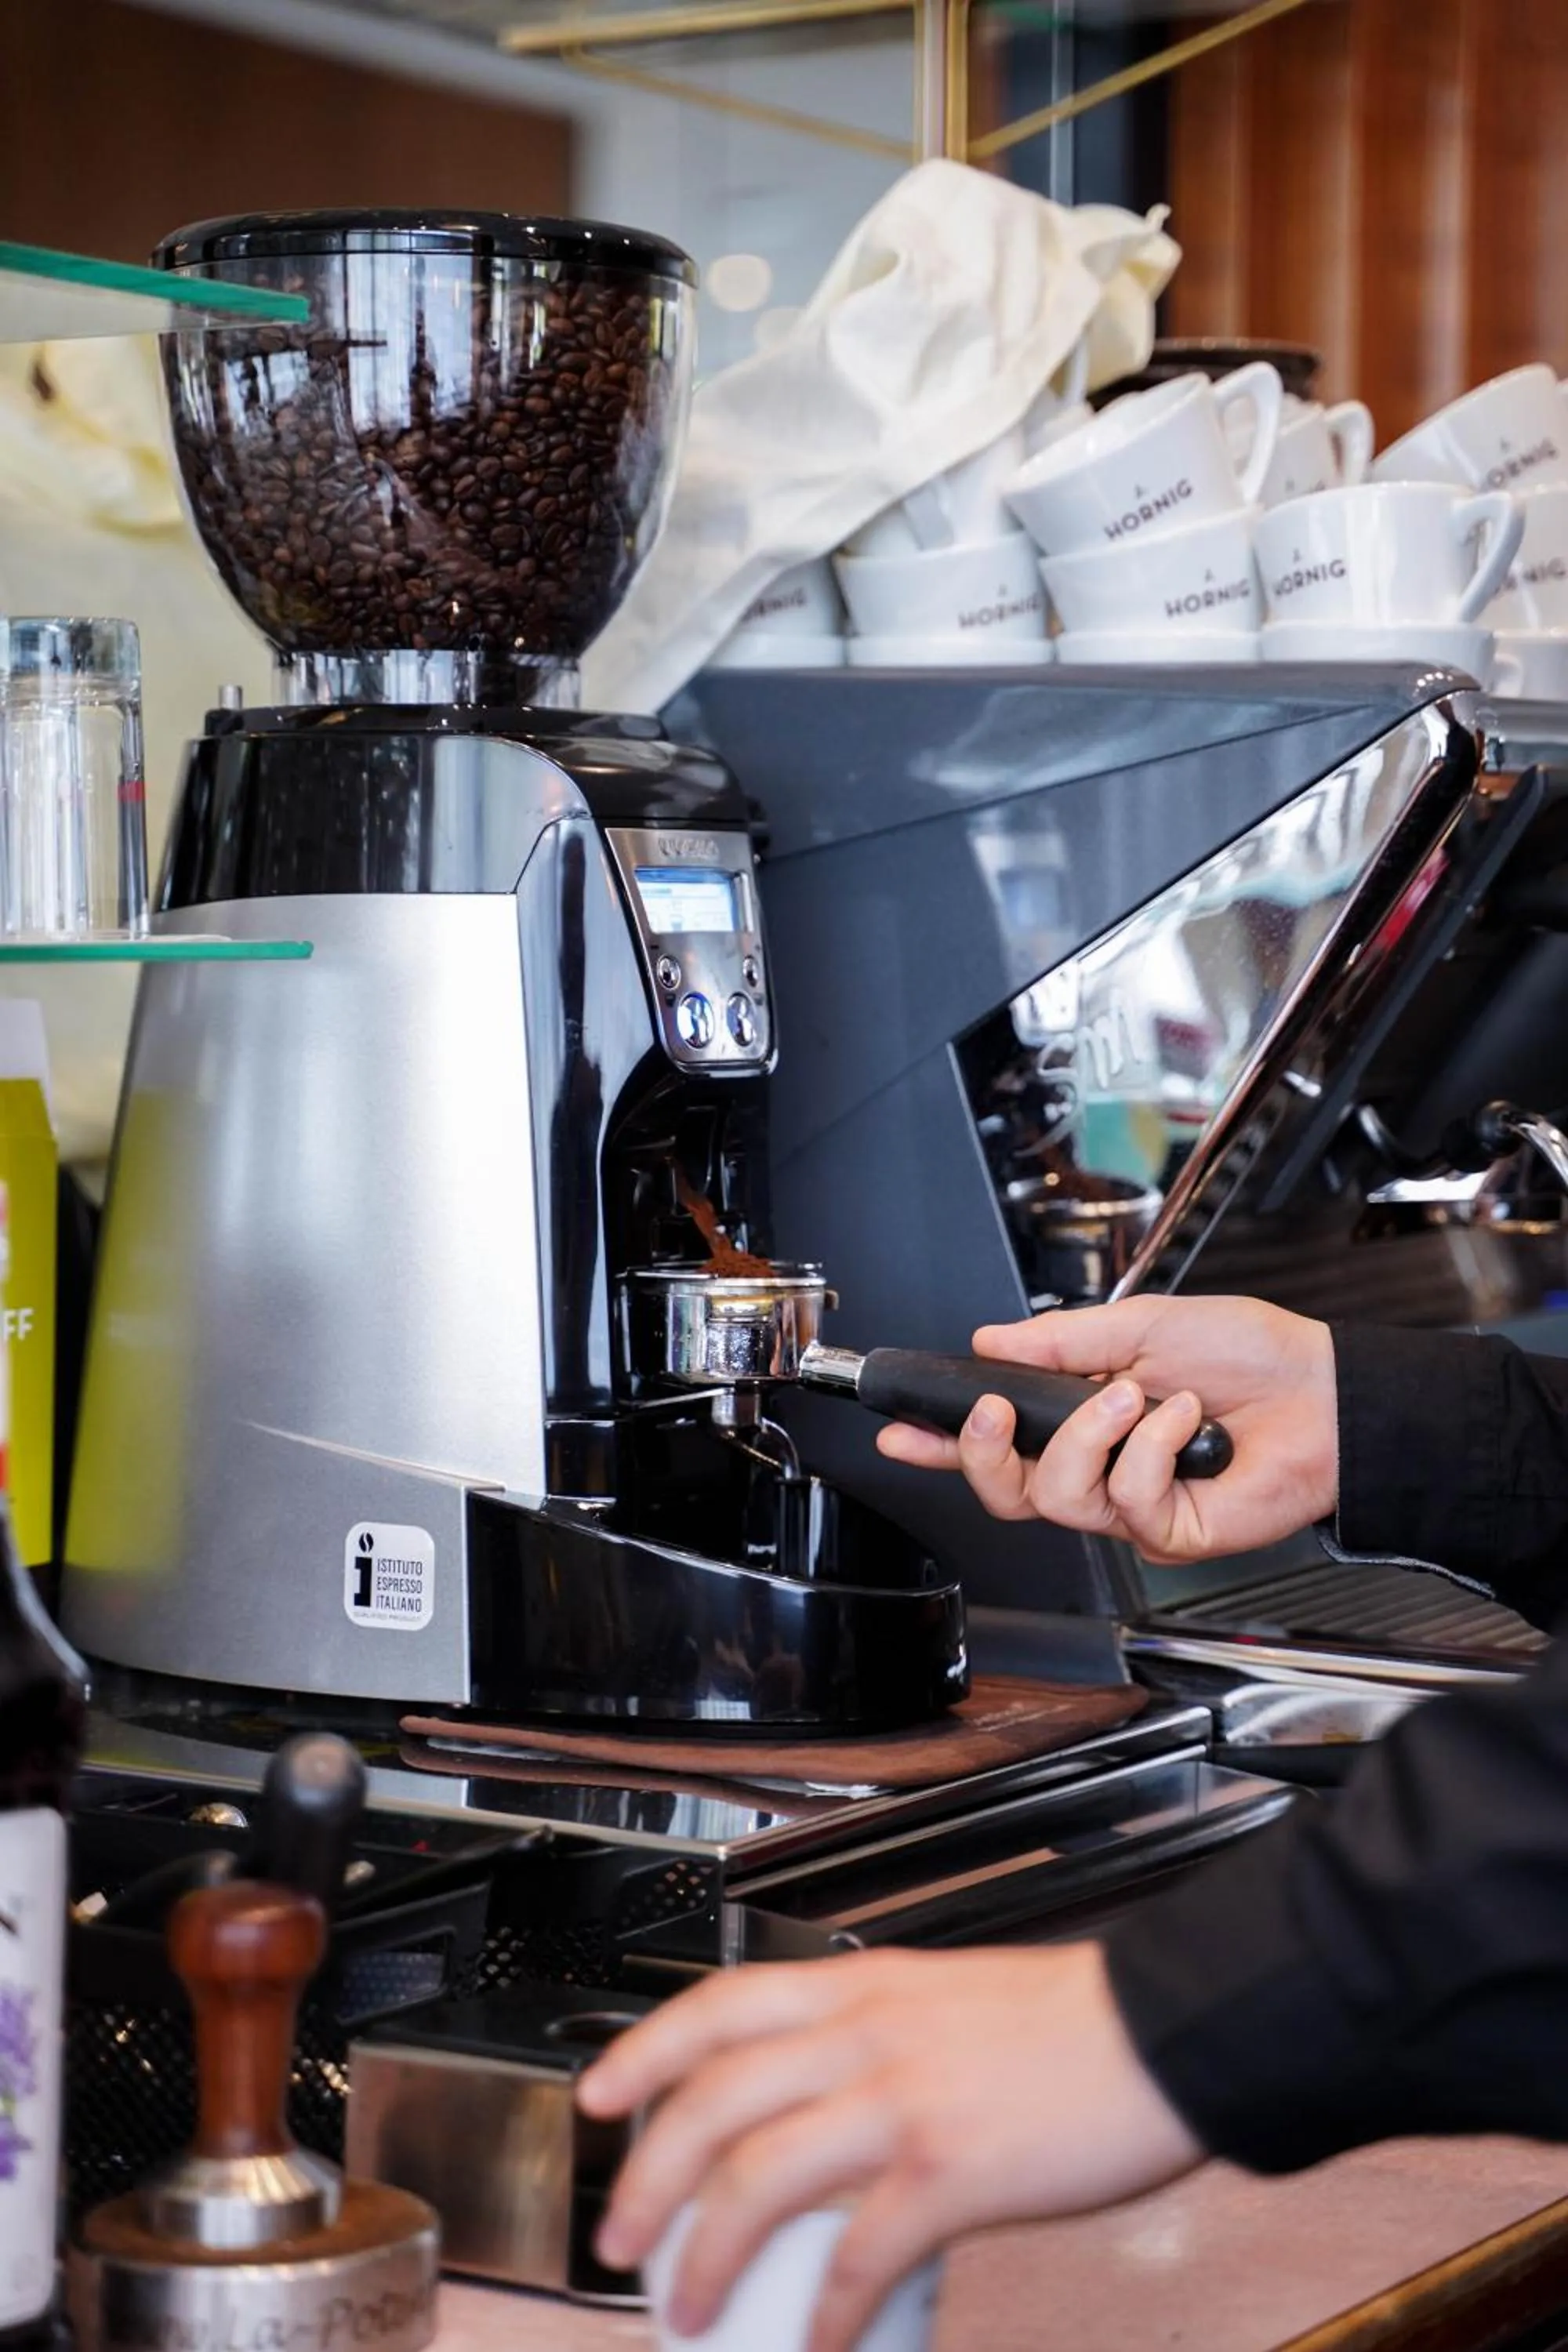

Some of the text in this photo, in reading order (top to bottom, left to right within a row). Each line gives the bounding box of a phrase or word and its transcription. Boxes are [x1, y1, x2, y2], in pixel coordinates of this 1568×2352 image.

[1103, 478, 1192, 542] HORNIG
[1163, 578, 1250, 619] HORNIG
[377, 1558, 423, 1576] ISTITUTO
[376, 1576, 423, 1594] ESPRESSO
[376, 1595, 422, 1613] ITALIANO
